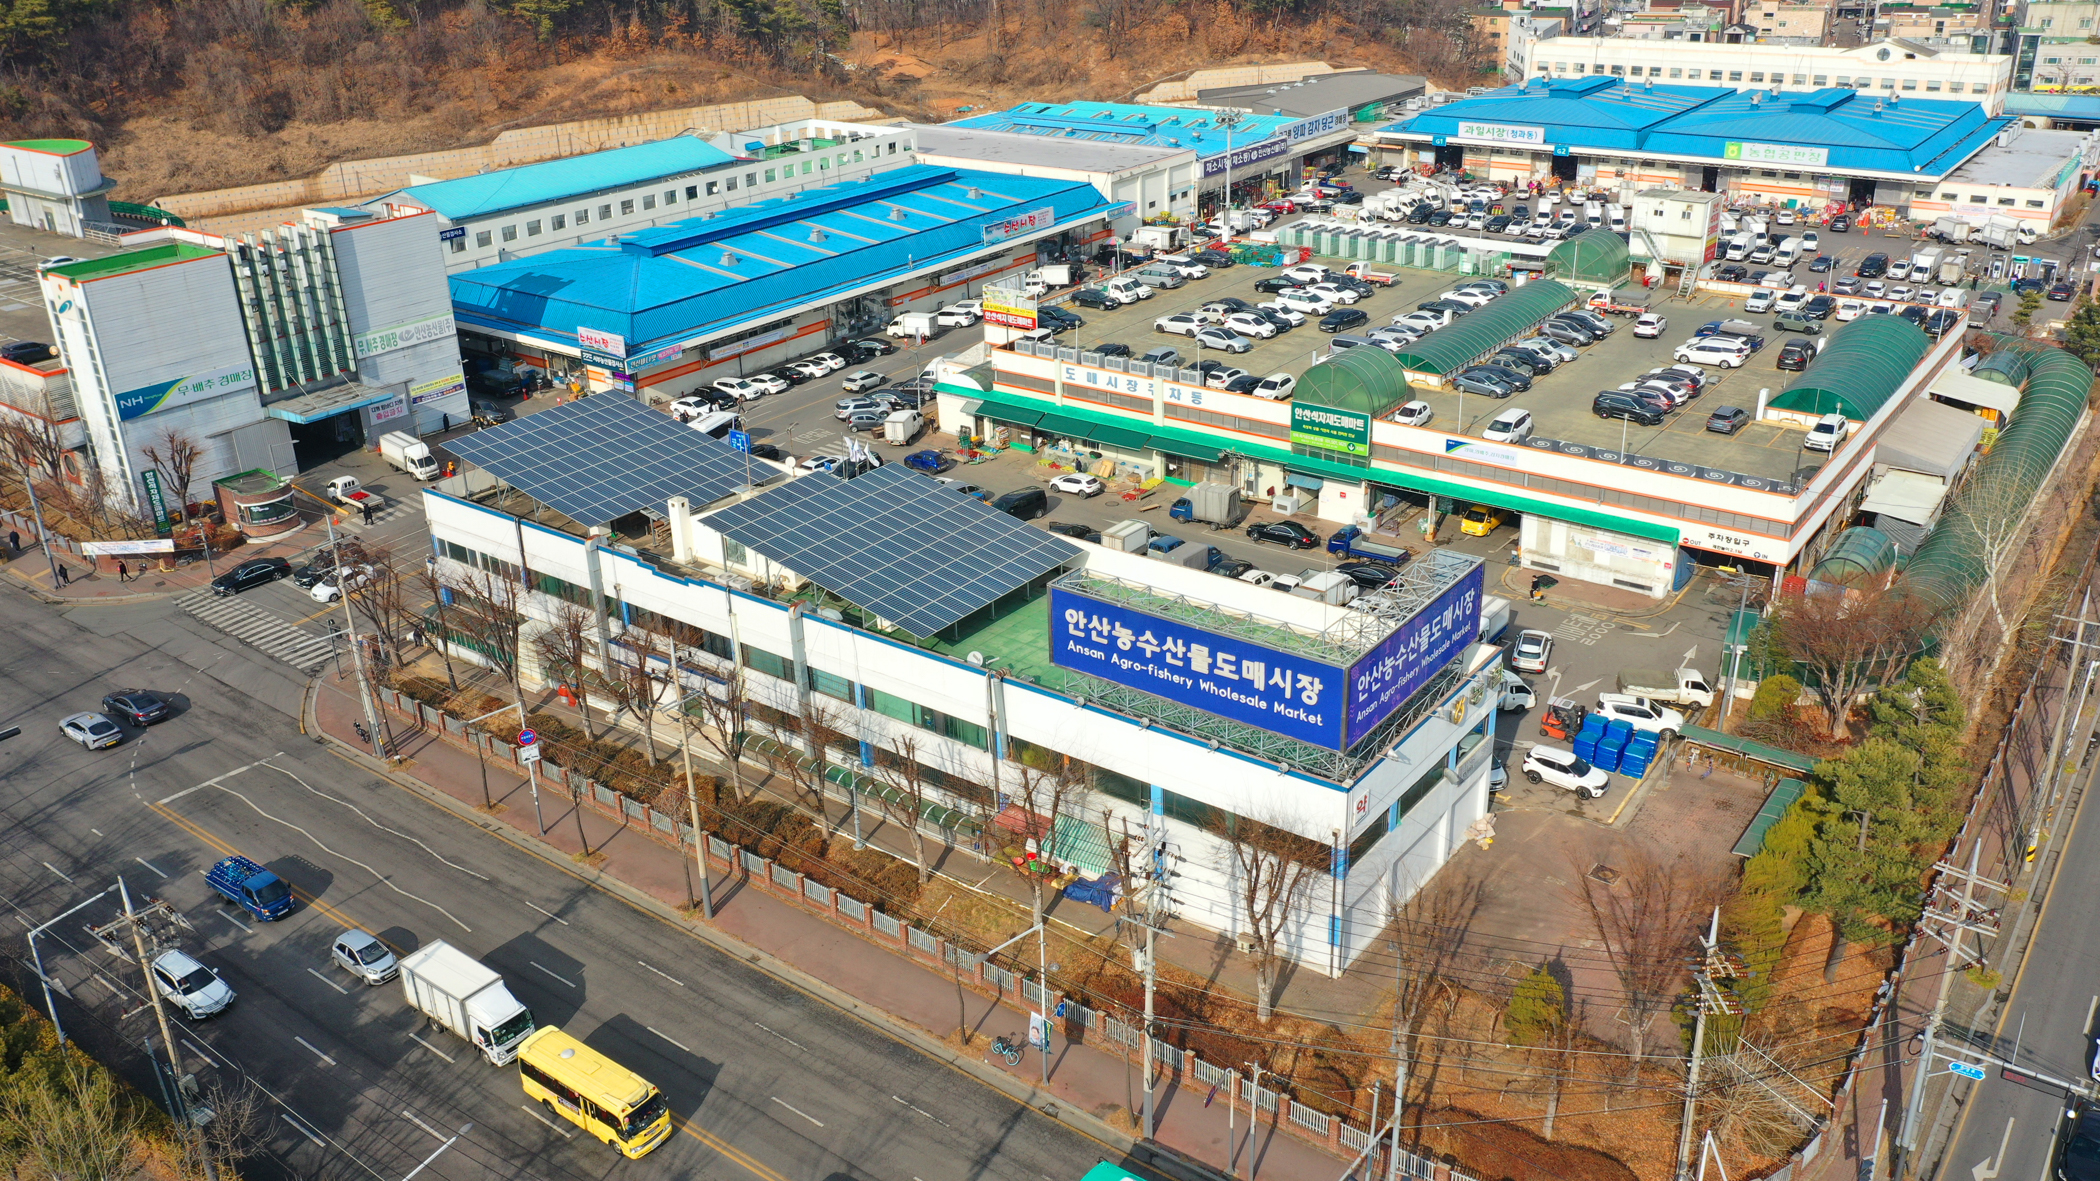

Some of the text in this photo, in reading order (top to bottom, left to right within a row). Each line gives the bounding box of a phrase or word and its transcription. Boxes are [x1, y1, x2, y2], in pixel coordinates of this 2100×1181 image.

[1292, 124, 1306, 139] 양파
[1307, 119, 1320, 136] 감자
[1321, 115, 1334, 131] 당근
[1749, 147, 1821, 163] 농협공판장
[414, 318, 455, 340] 안산농산물(주)
[218, 369, 253, 387] 경매장
[120, 395, 144, 409] NH
[1294, 407, 1365, 431] 안산식자재도매마트
[1708, 532, 1750, 546] 주차장입구
[1357, 587, 1475, 703] 안산농수산물도매시장
[1065, 608, 1323, 706] 안산농수산물도매시장
[1067, 639, 1323, 727] Ansan Agro-fishery Wholesale Market
[1356, 620, 1471, 724] Ansan Agro-fishery Wholesale Market
[1356, 794, 1367, 814] 약
